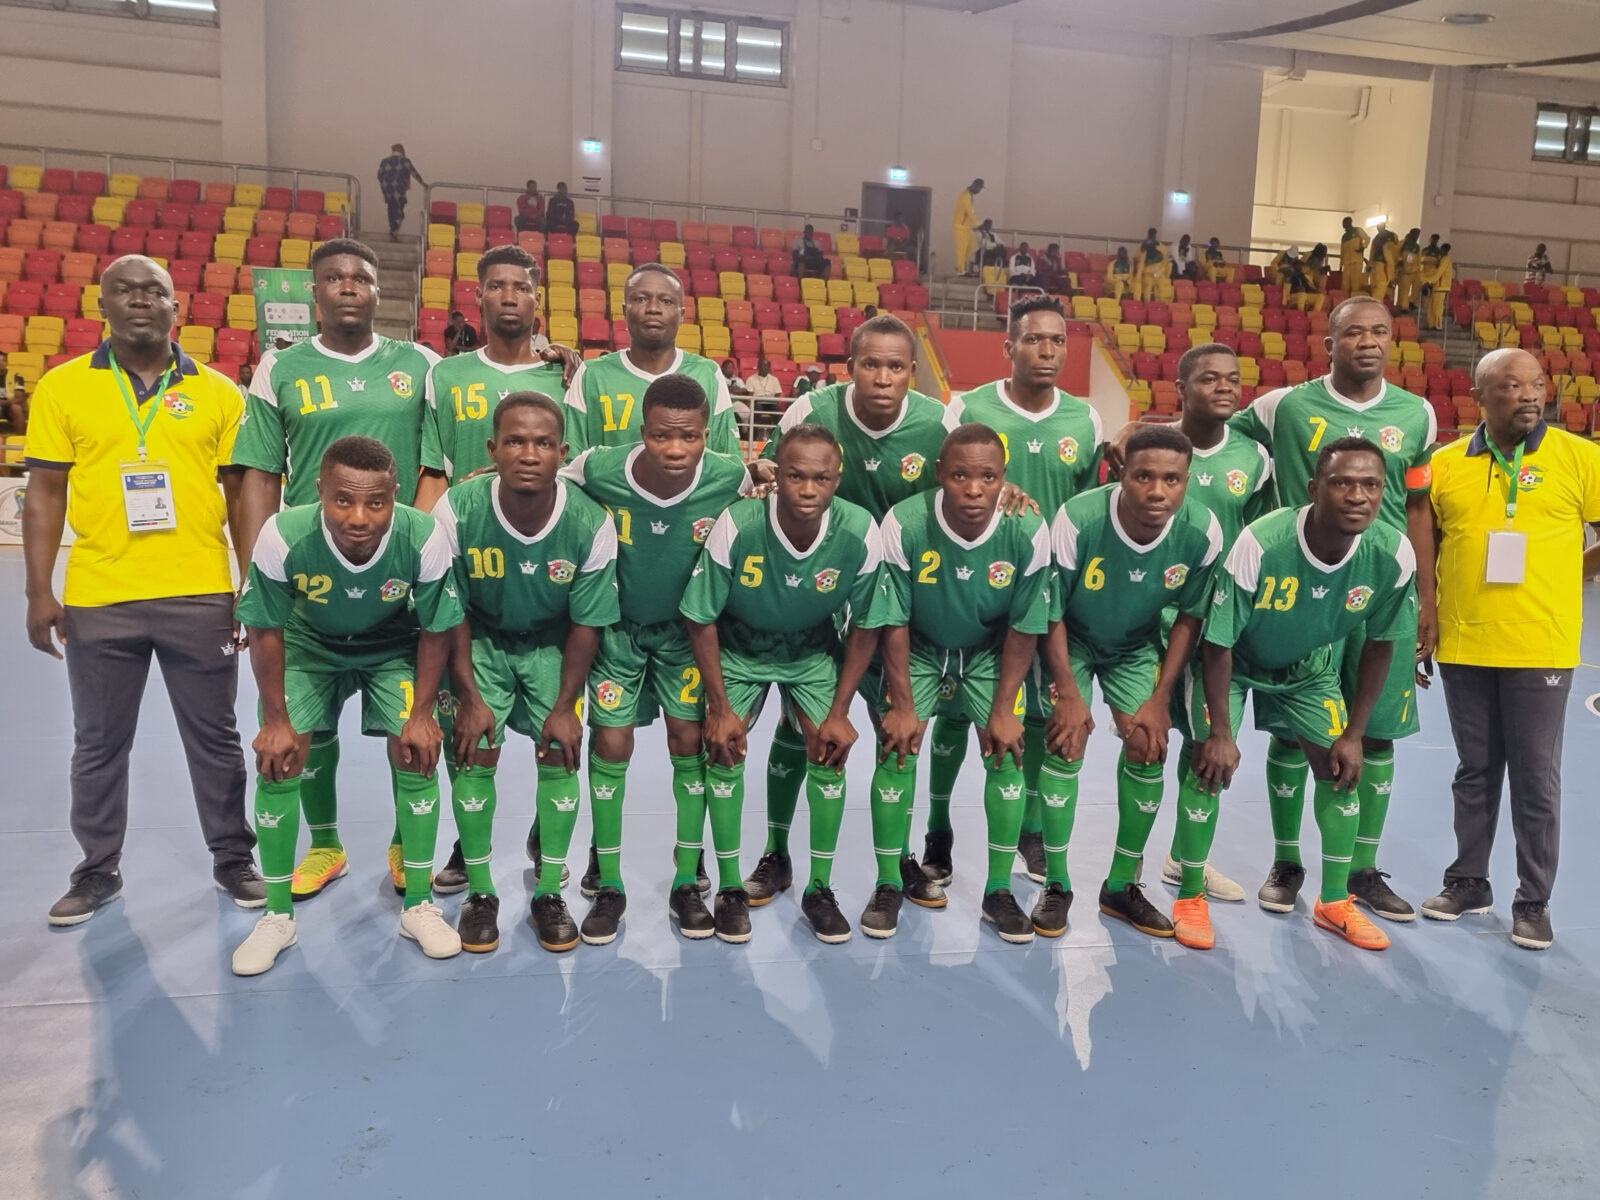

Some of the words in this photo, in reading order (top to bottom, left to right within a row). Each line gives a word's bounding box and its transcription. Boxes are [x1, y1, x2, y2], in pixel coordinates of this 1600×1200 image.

[295, 375, 338, 415] 11
[451, 383, 488, 422] 15
[600, 393, 635, 432] 17
[1308, 416, 1328, 452] 7
[467, 546, 505, 579] 10
[740, 555, 764, 588] 5
[917, 550, 942, 584] 2
[1084, 557, 1106, 591] 6
[293, 573, 333, 605] 12
[1255, 576, 1299, 611] 13
[399, 681, 415, 719] 1
[680, 667, 702, 704] 2
